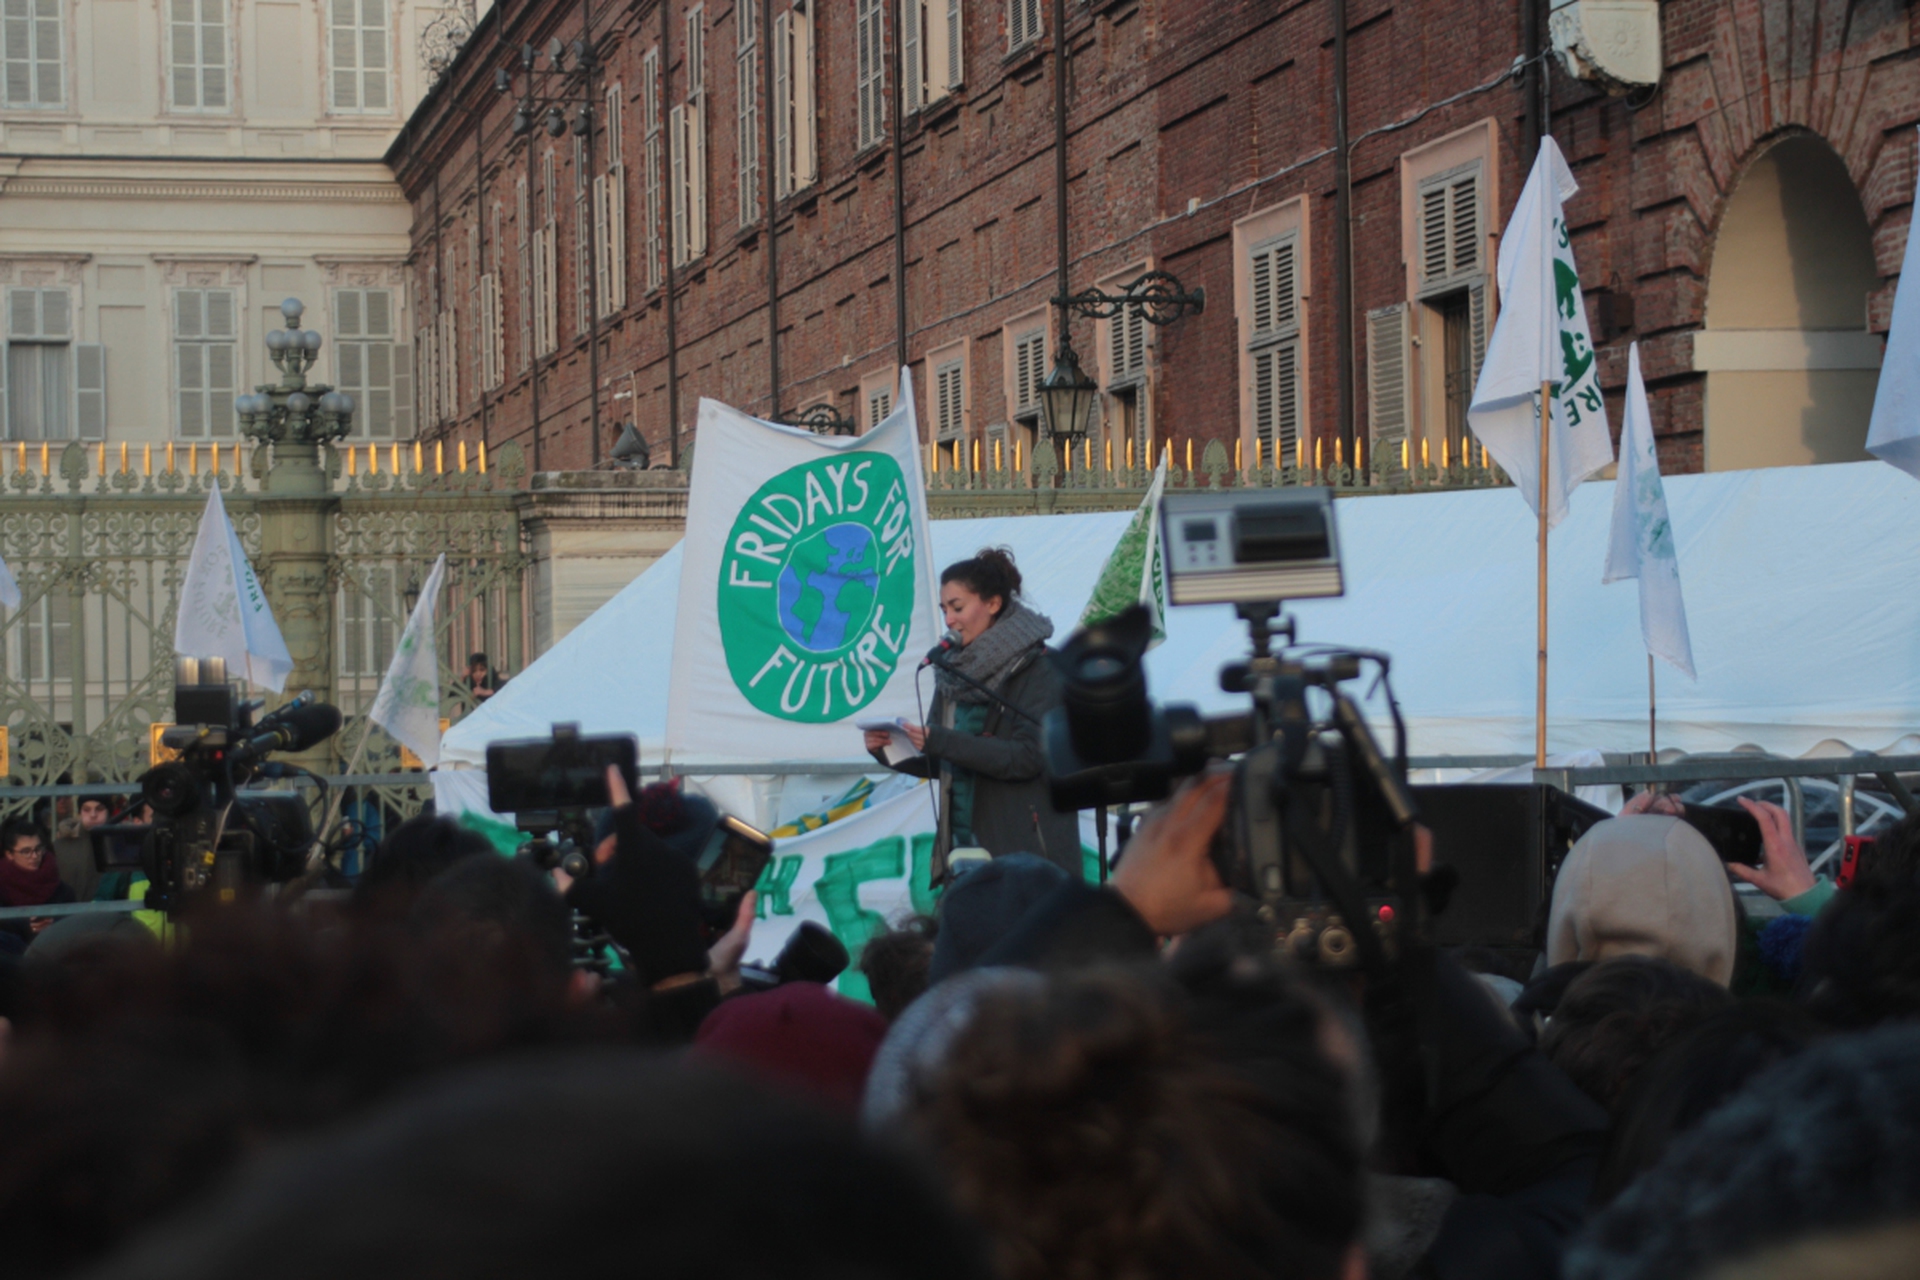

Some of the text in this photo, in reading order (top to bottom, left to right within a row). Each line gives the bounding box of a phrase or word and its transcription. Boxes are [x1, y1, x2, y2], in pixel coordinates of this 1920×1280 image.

[729, 460, 913, 588] FRIDAYS FOR
[749, 604, 906, 715] FUTURE
